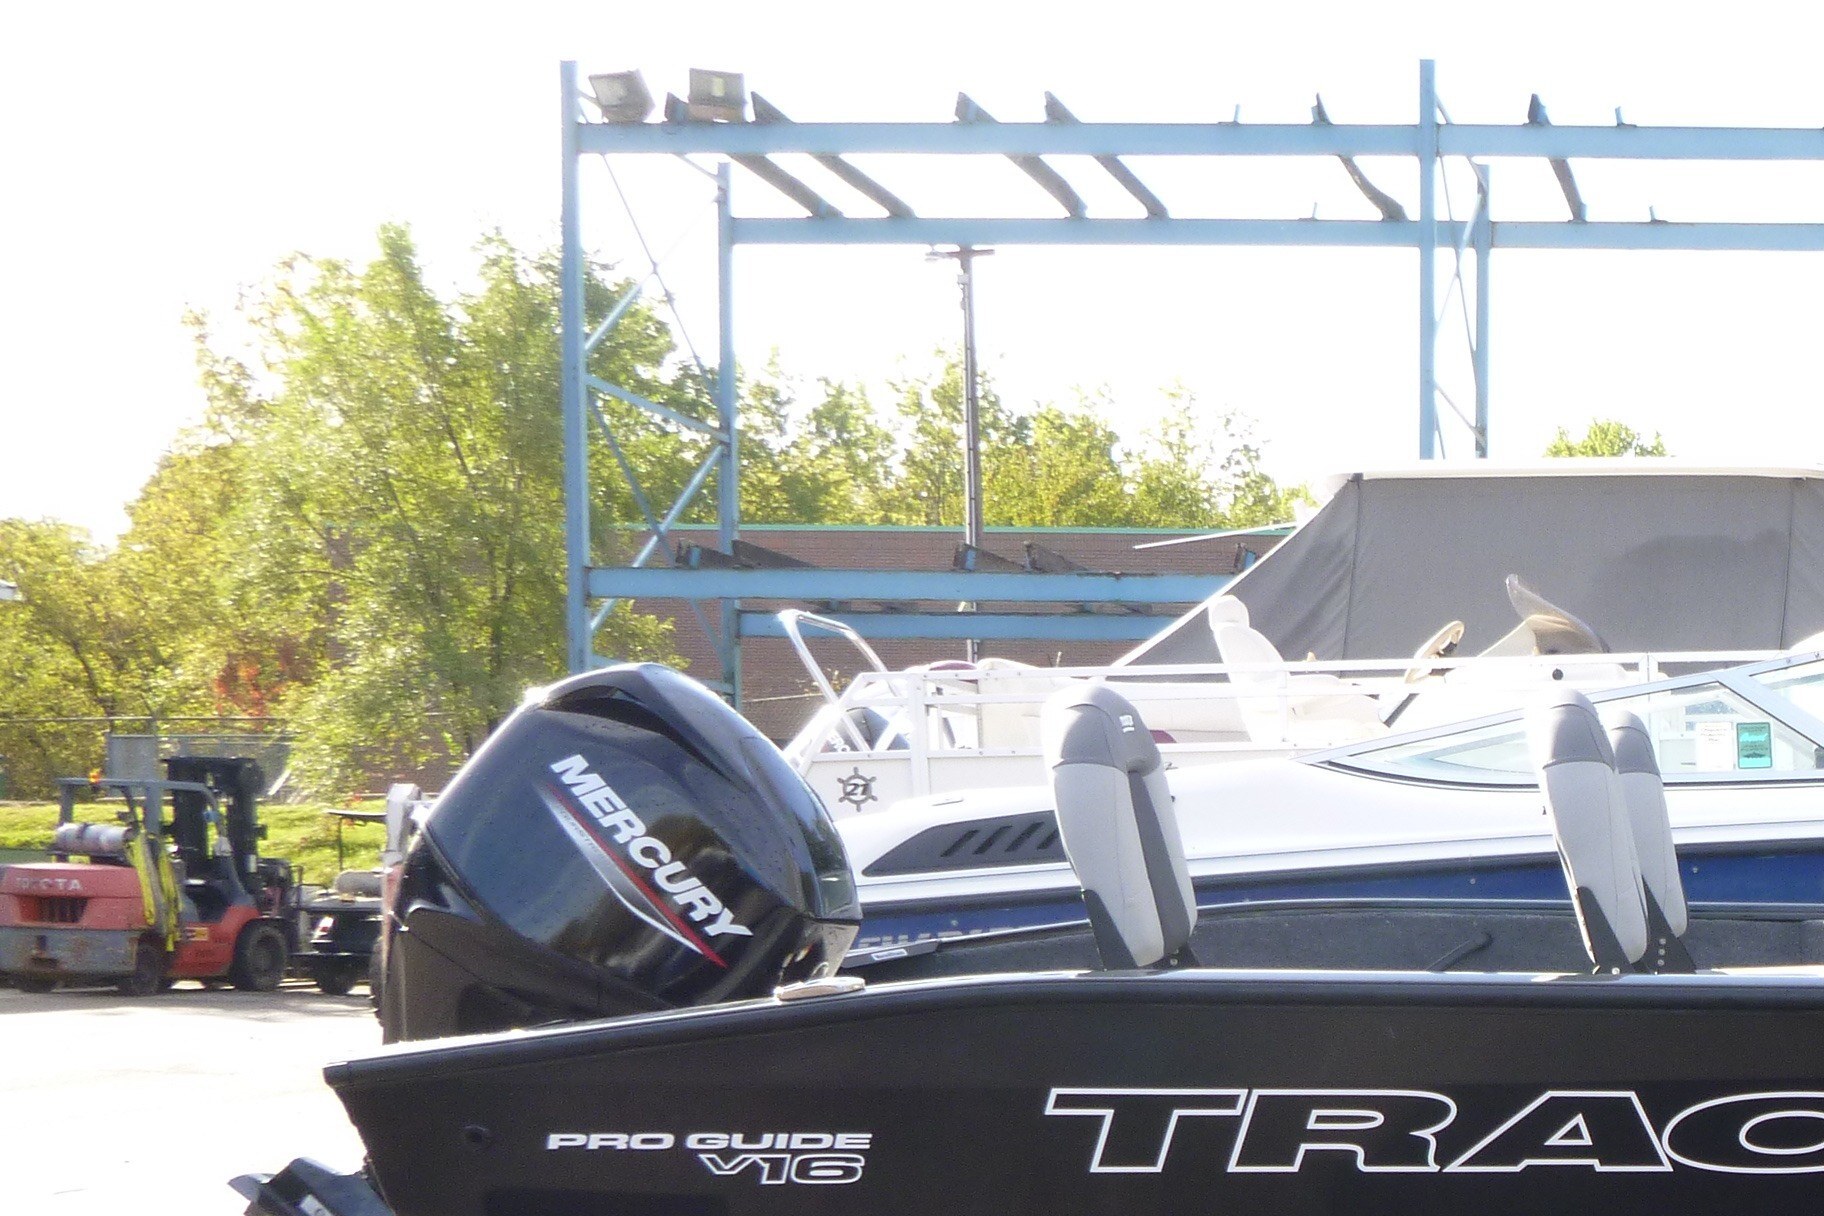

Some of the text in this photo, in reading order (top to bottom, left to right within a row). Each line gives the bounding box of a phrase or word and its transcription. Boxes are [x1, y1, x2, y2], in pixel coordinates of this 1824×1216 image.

[845, 783, 869, 796] 21
[550, 754, 754, 937] MERCURY
[16, 878, 83, 890] OOTA
[546, 1133, 873, 1150] PRO GUIDE
[698, 1153, 865, 1185] V16
